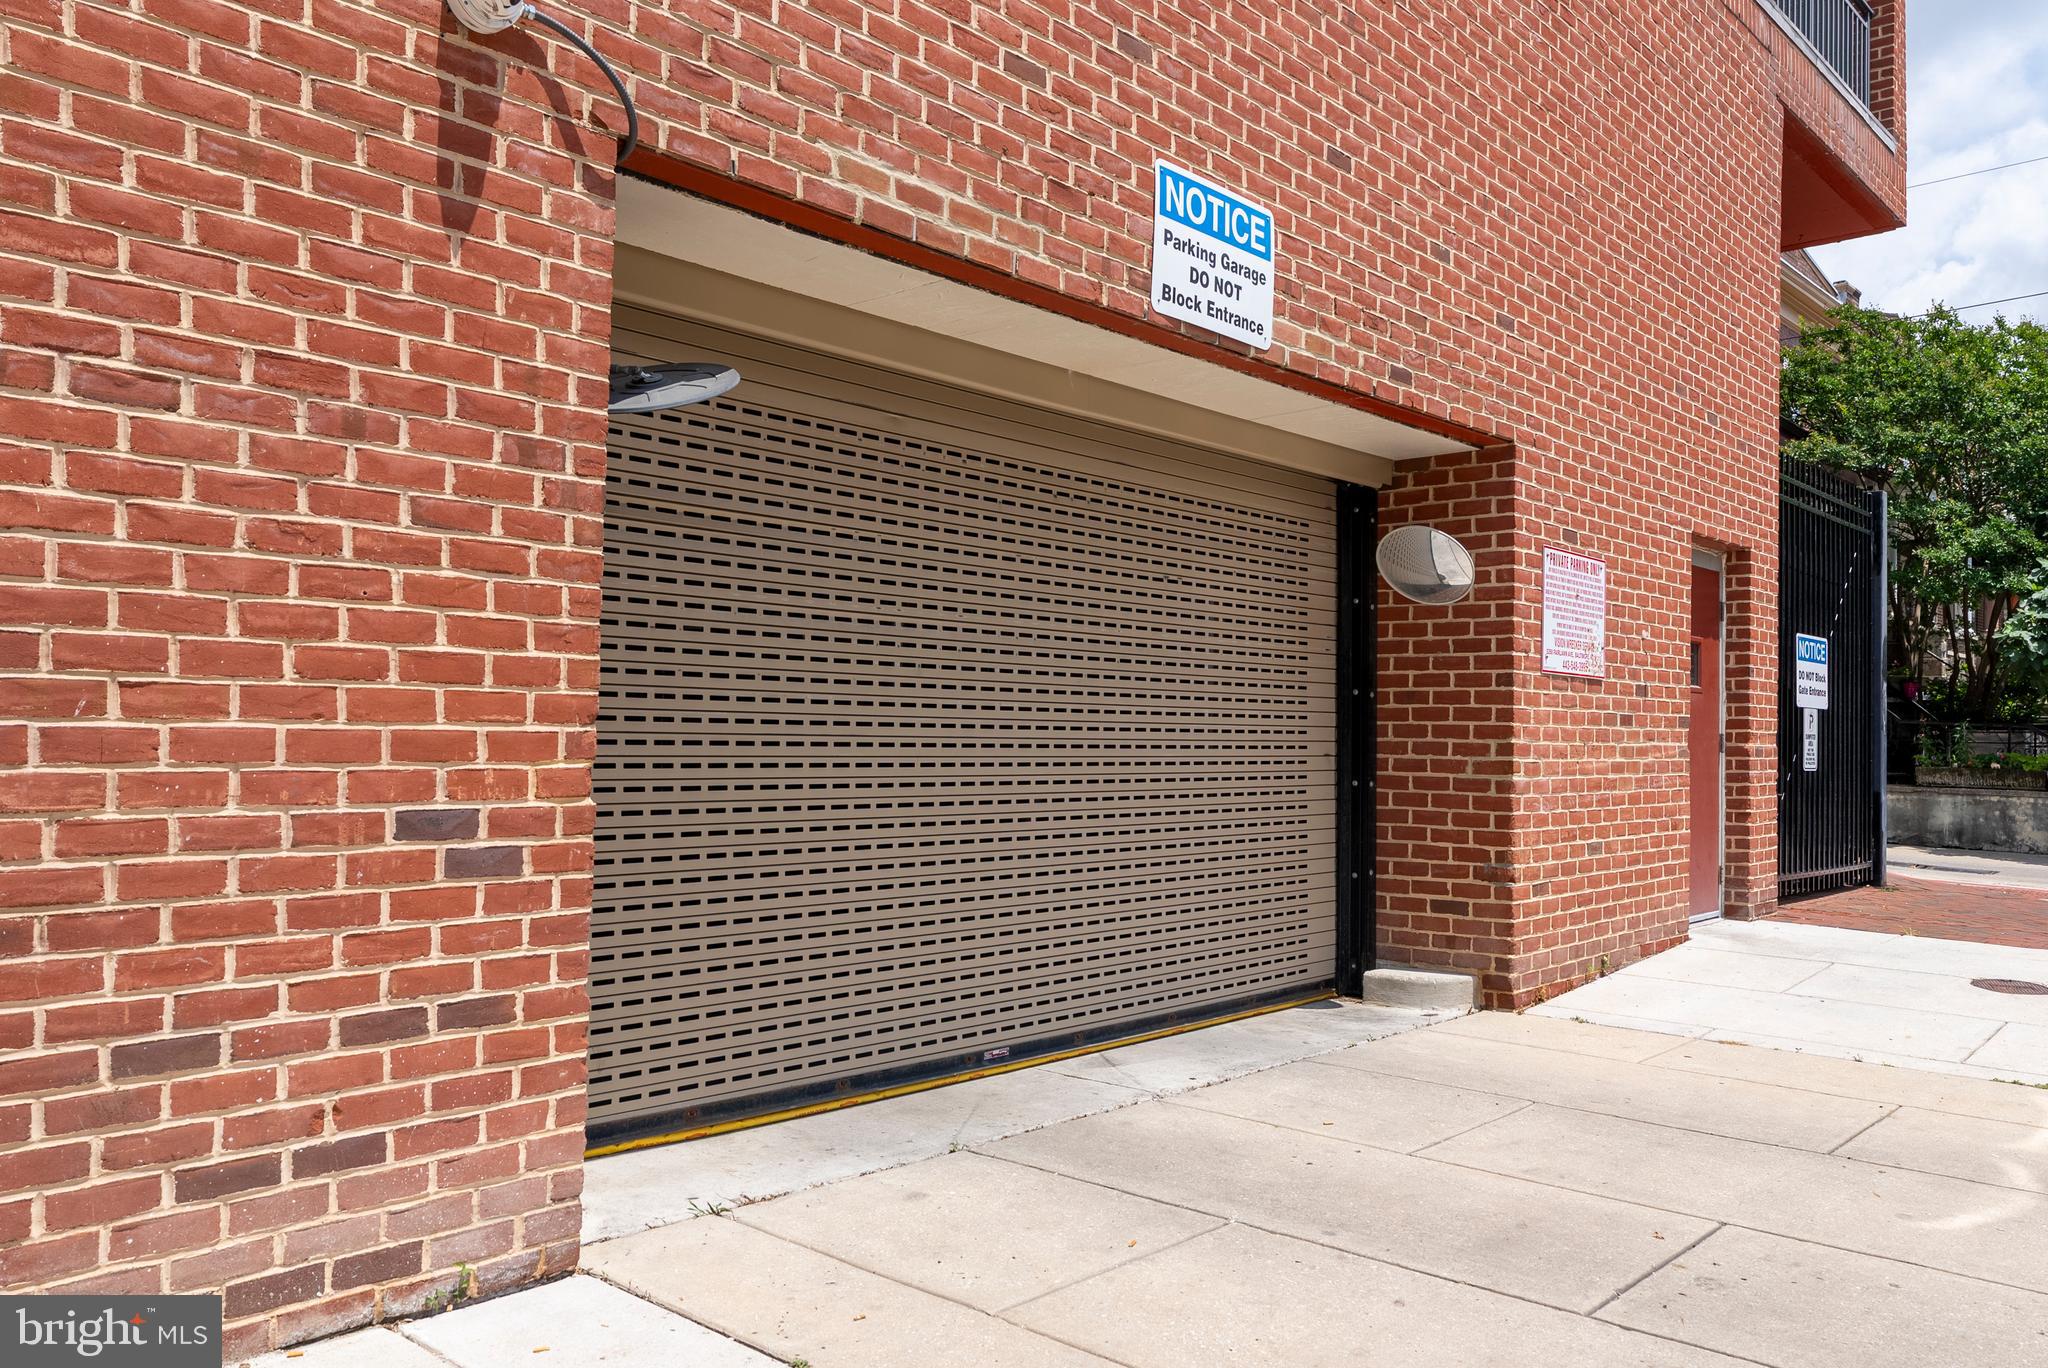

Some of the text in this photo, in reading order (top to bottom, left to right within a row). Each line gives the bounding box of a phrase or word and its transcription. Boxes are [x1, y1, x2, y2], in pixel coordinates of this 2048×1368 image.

[1166, 175, 1266, 253] NOTICE
[1163, 228, 1267, 286] Parking Garage
[1189, 266, 1242, 301] DO NOT
[1161, 283, 1265, 336] Block Entrance
[1550, 552, 1569, 569] PRIVATE
[1570, 557, 1589, 574] PARKING
[1590, 562, 1601, 577] ONLY
[1798, 639, 1826, 662] NOTICE
[1798, 670, 1826, 683] DO NOT Block
[1798, 685, 1826, 697] Gate Entrance
